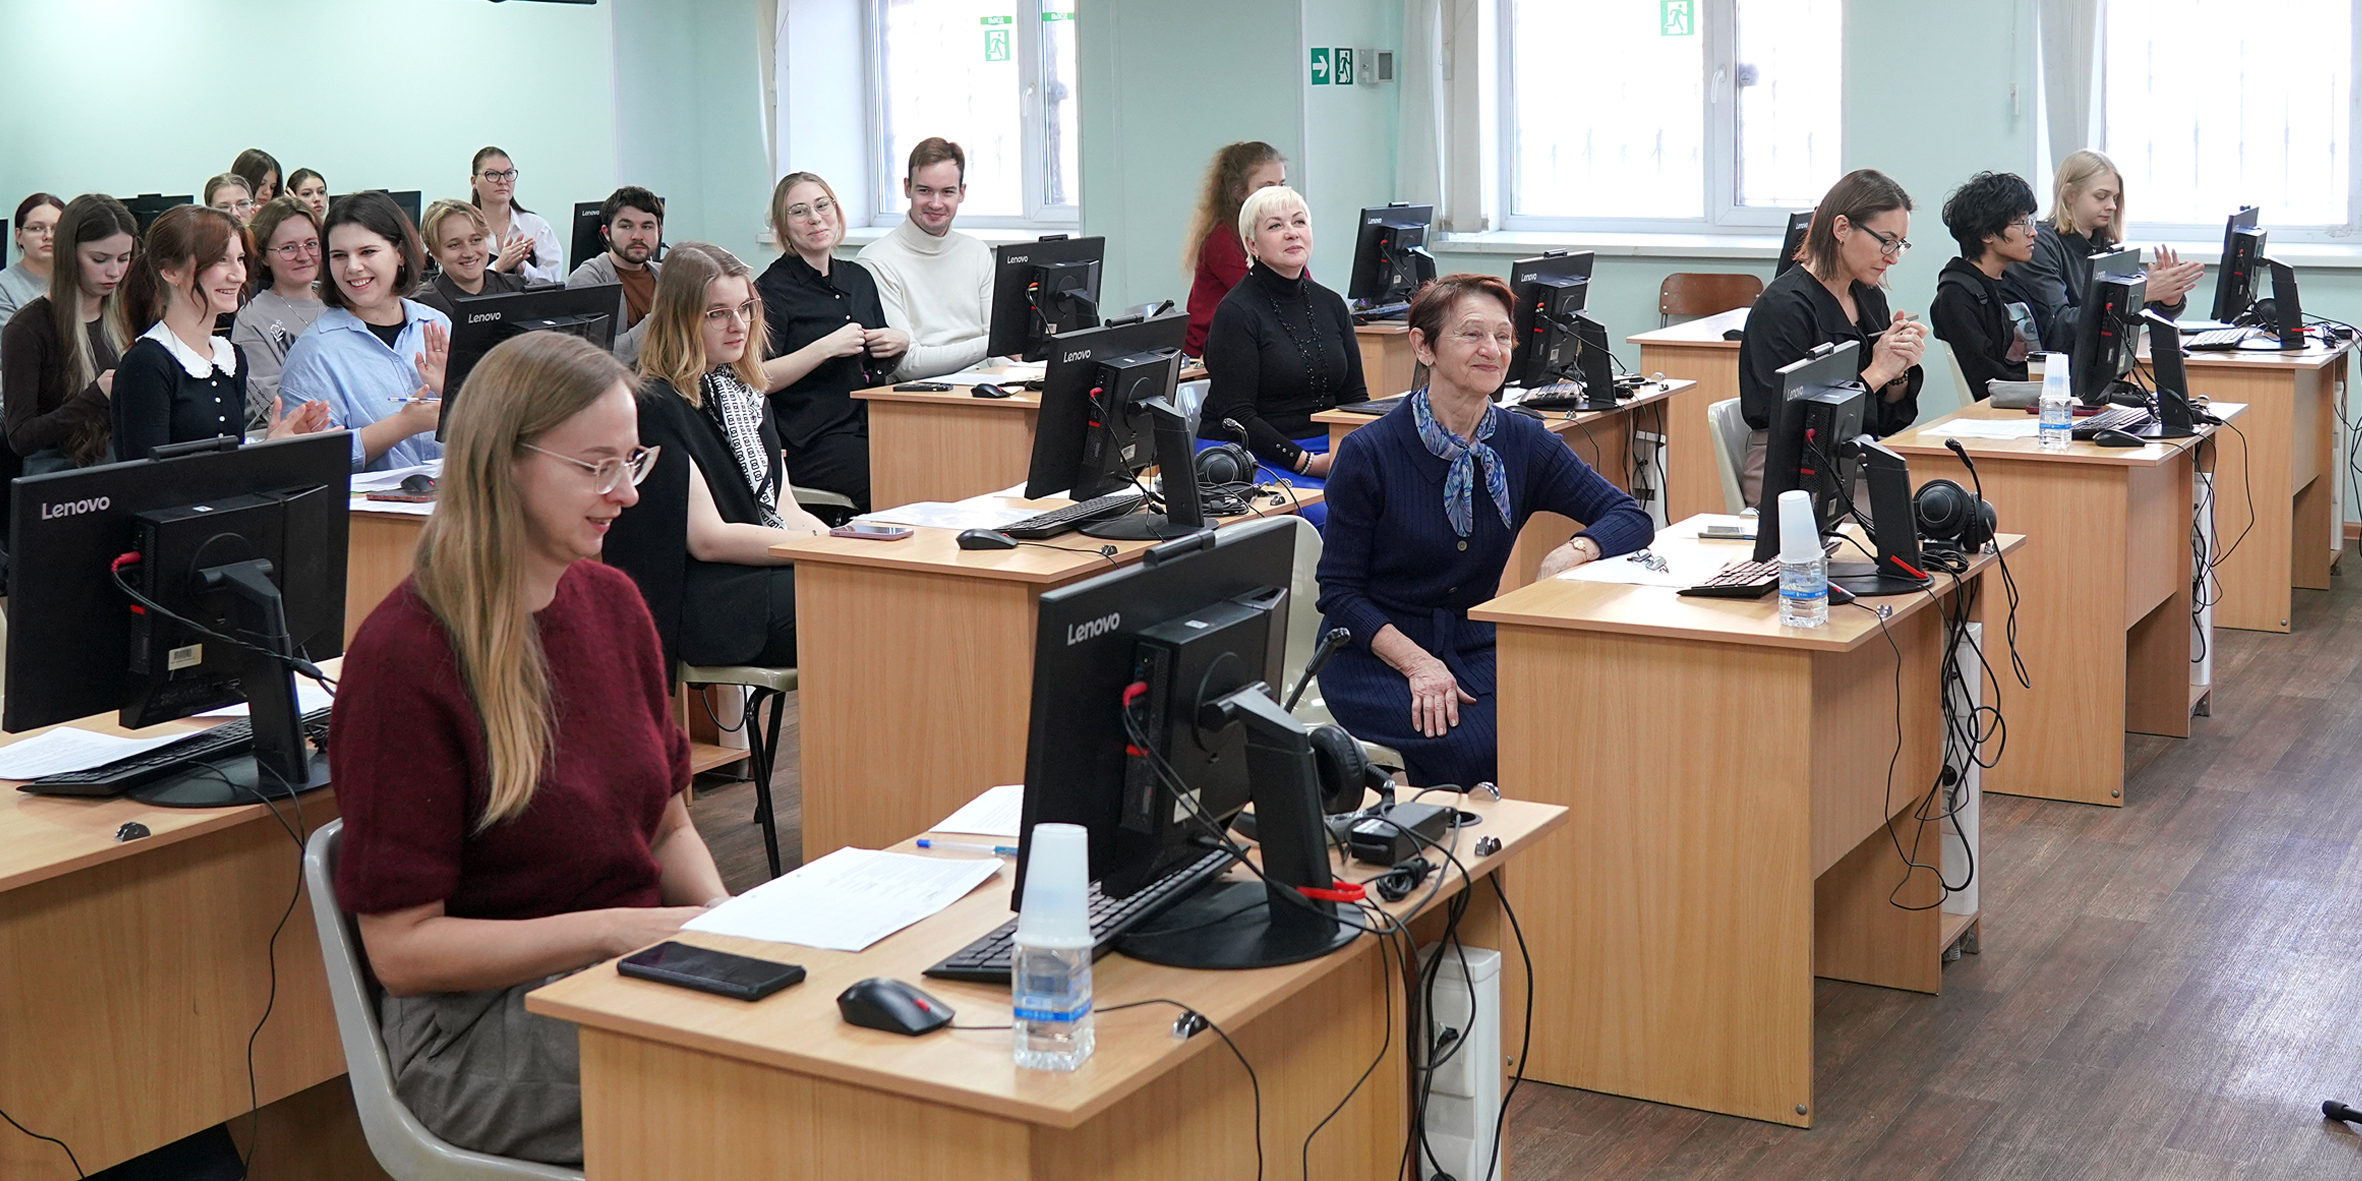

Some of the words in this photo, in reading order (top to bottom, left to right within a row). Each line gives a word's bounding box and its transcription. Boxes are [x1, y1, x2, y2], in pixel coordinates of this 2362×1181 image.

[1367, 217, 1382, 225] Lenovo
[1007, 255, 1028, 264] Lenovo
[1521, 273, 1537, 283] Lenovo
[468, 311, 501, 324] Lenovo
[1063, 349, 1091, 363] Lenovo
[1787, 385, 1804, 402] Lenovo
[42, 496, 110, 520] Lenovo
[1067, 612, 1121, 646] Lenovo
